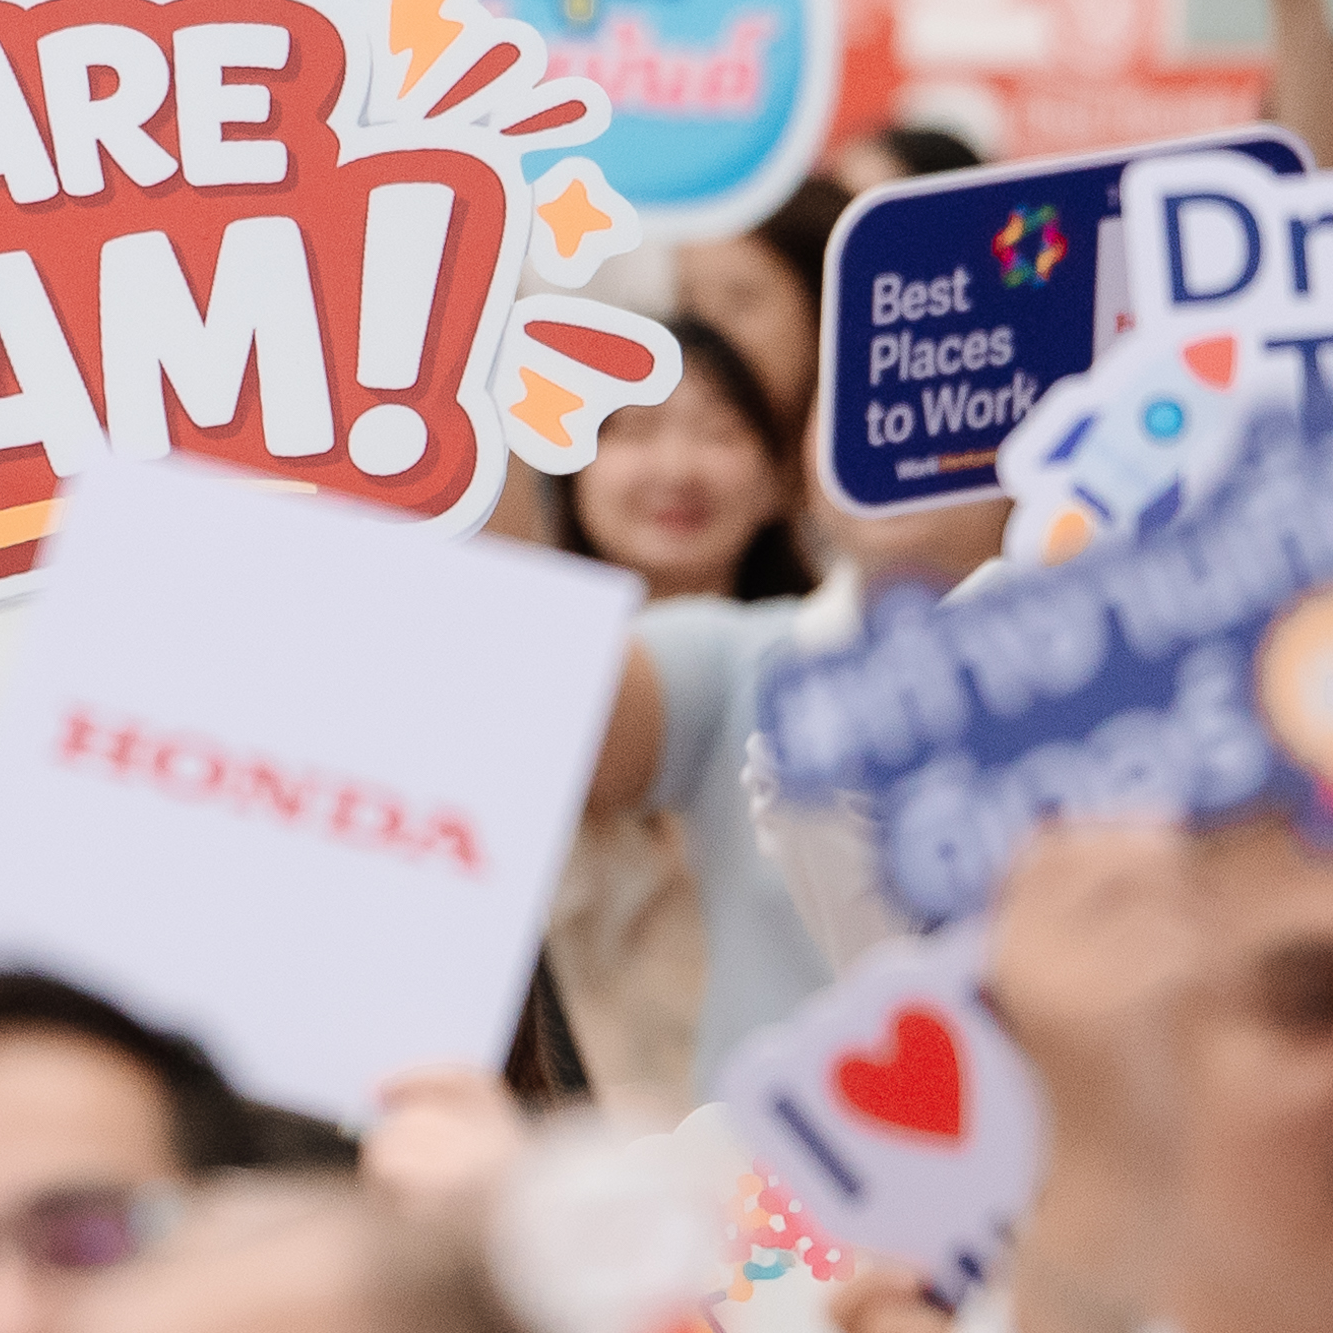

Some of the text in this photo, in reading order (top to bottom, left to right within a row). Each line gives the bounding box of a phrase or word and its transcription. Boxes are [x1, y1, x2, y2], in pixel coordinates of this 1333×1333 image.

[870, 266, 973, 327] Best
[868, 325, 1015, 388] Places
[866, 368, 1039, 449] to Work
[55, 700, 494, 884] HONDA
